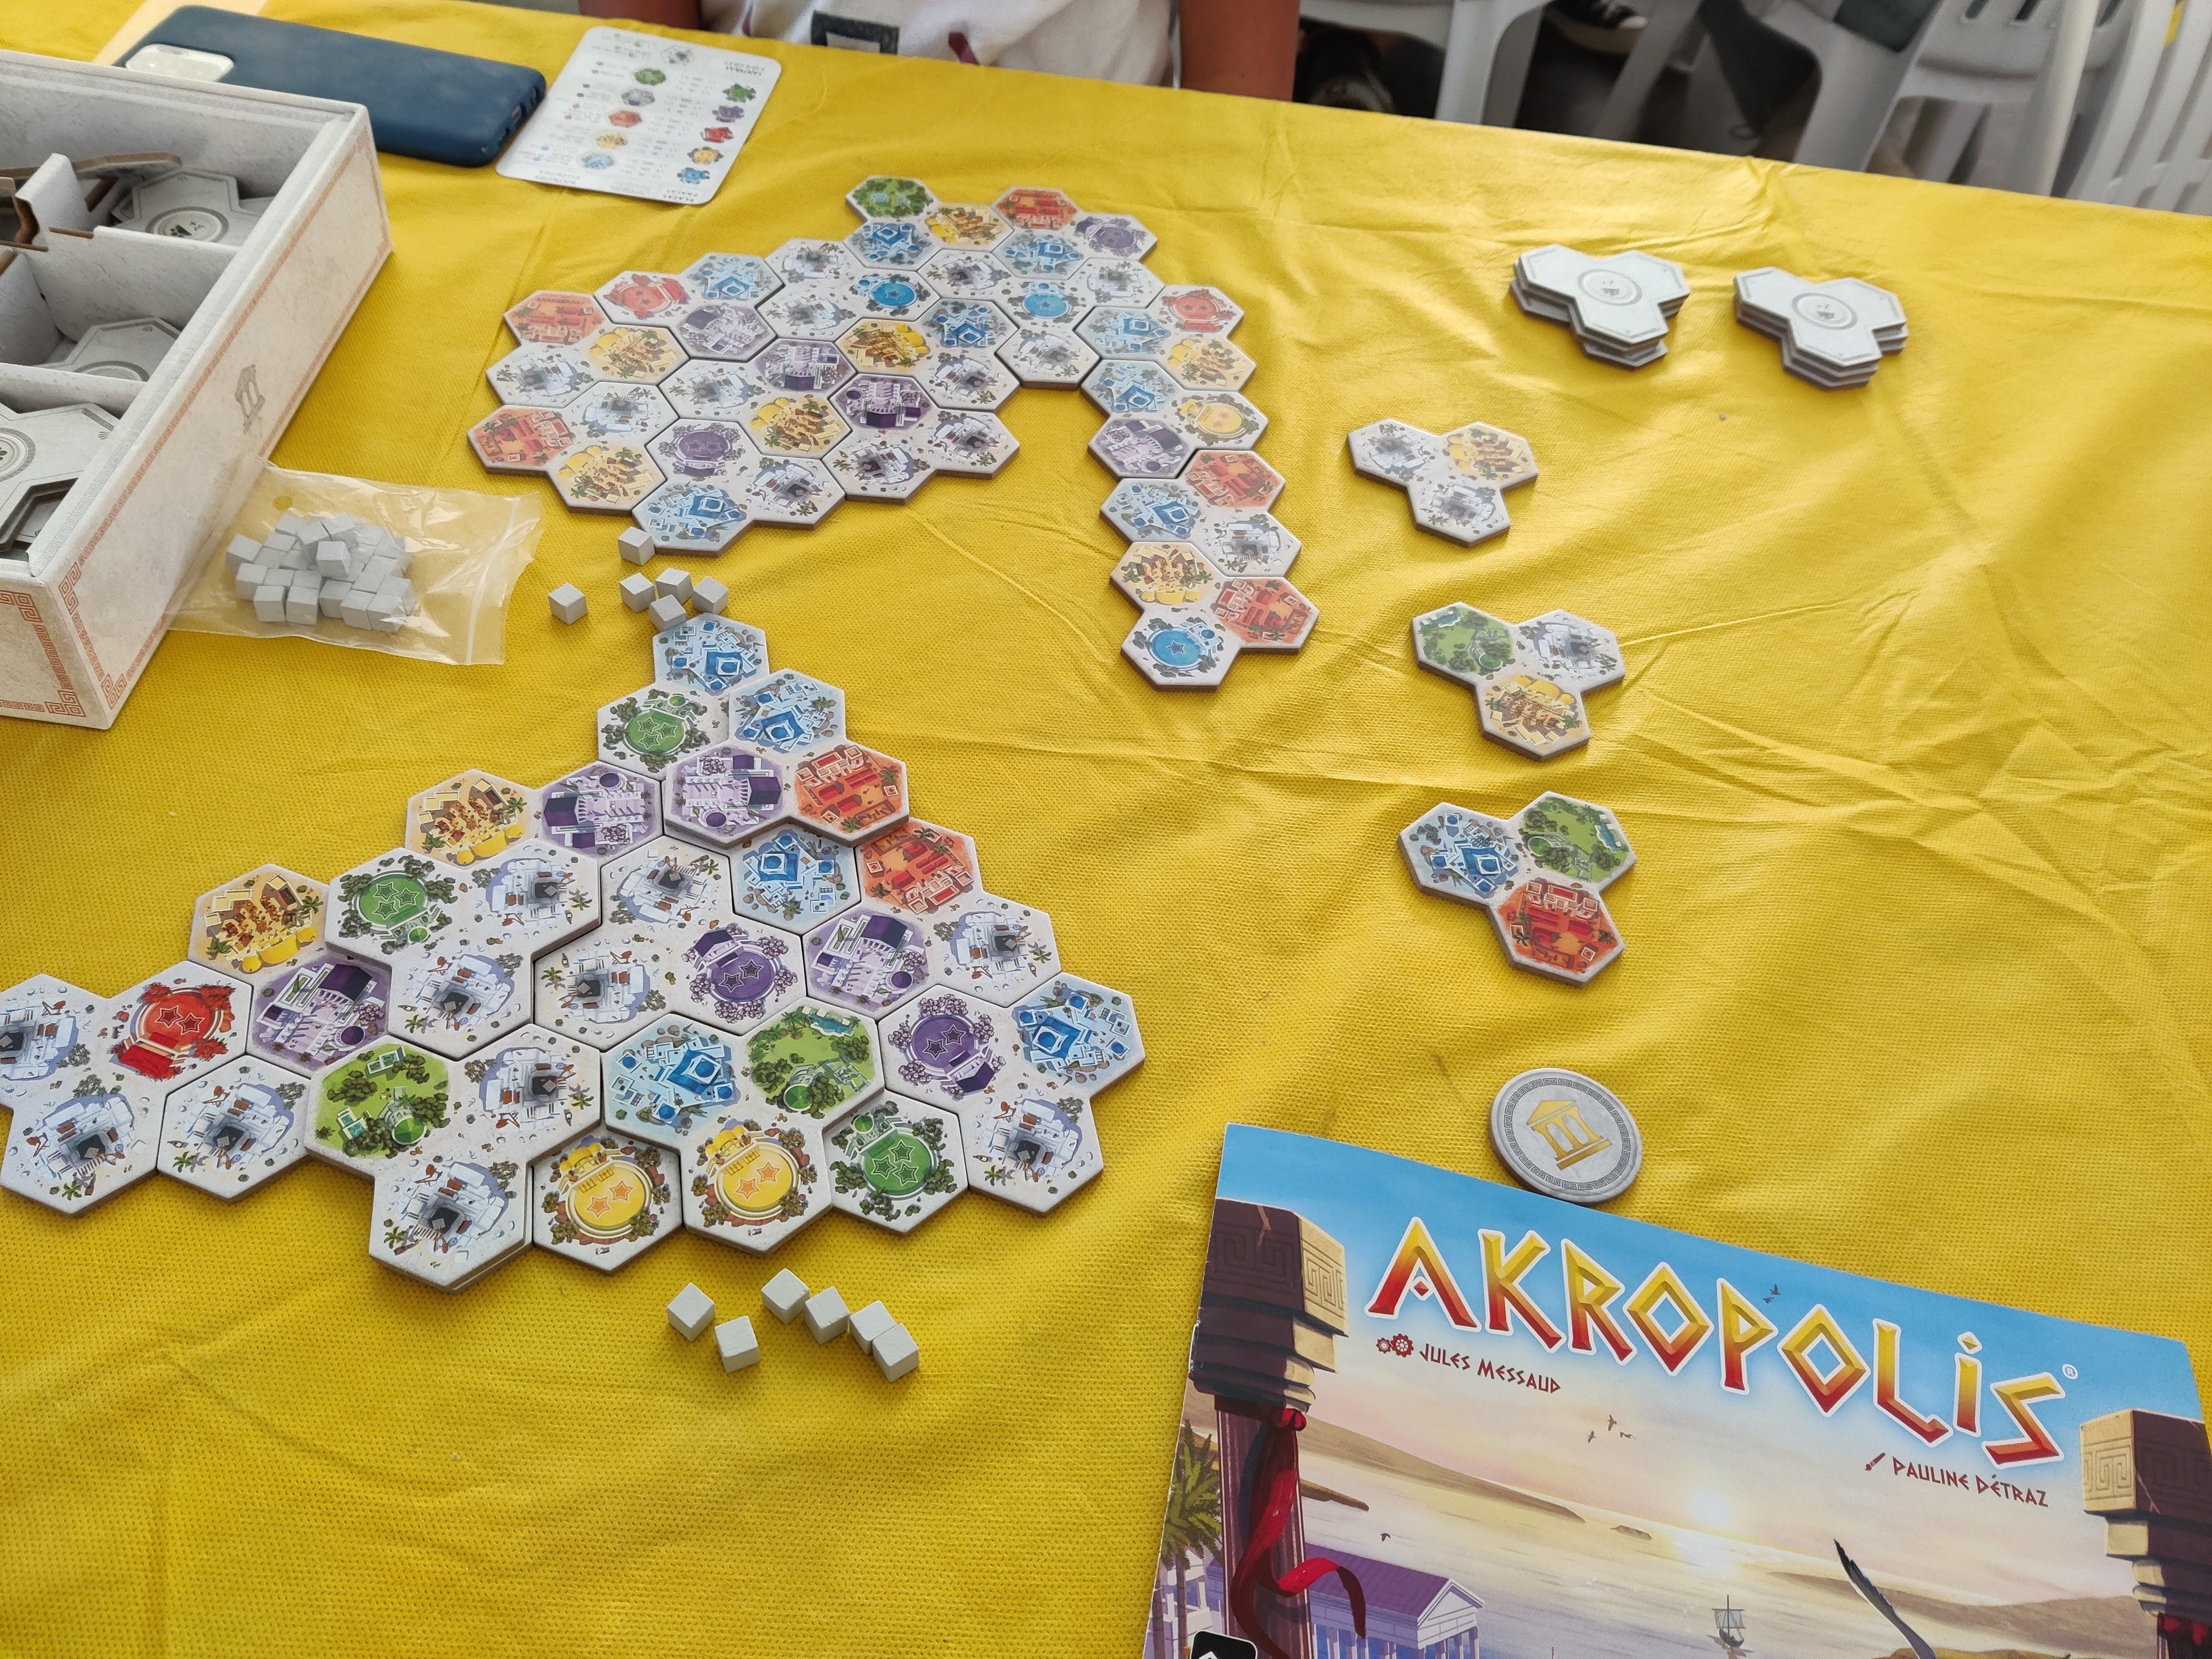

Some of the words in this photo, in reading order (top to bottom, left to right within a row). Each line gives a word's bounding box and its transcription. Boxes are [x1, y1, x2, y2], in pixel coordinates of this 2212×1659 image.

[1419, 1343, 1470, 1370] JULES
[1477, 1358, 1561, 1394] MESSAUD
[1893, 1457, 1970, 1490] PAULINE
[1976, 1474, 2049, 1508] DÉTRAZ
